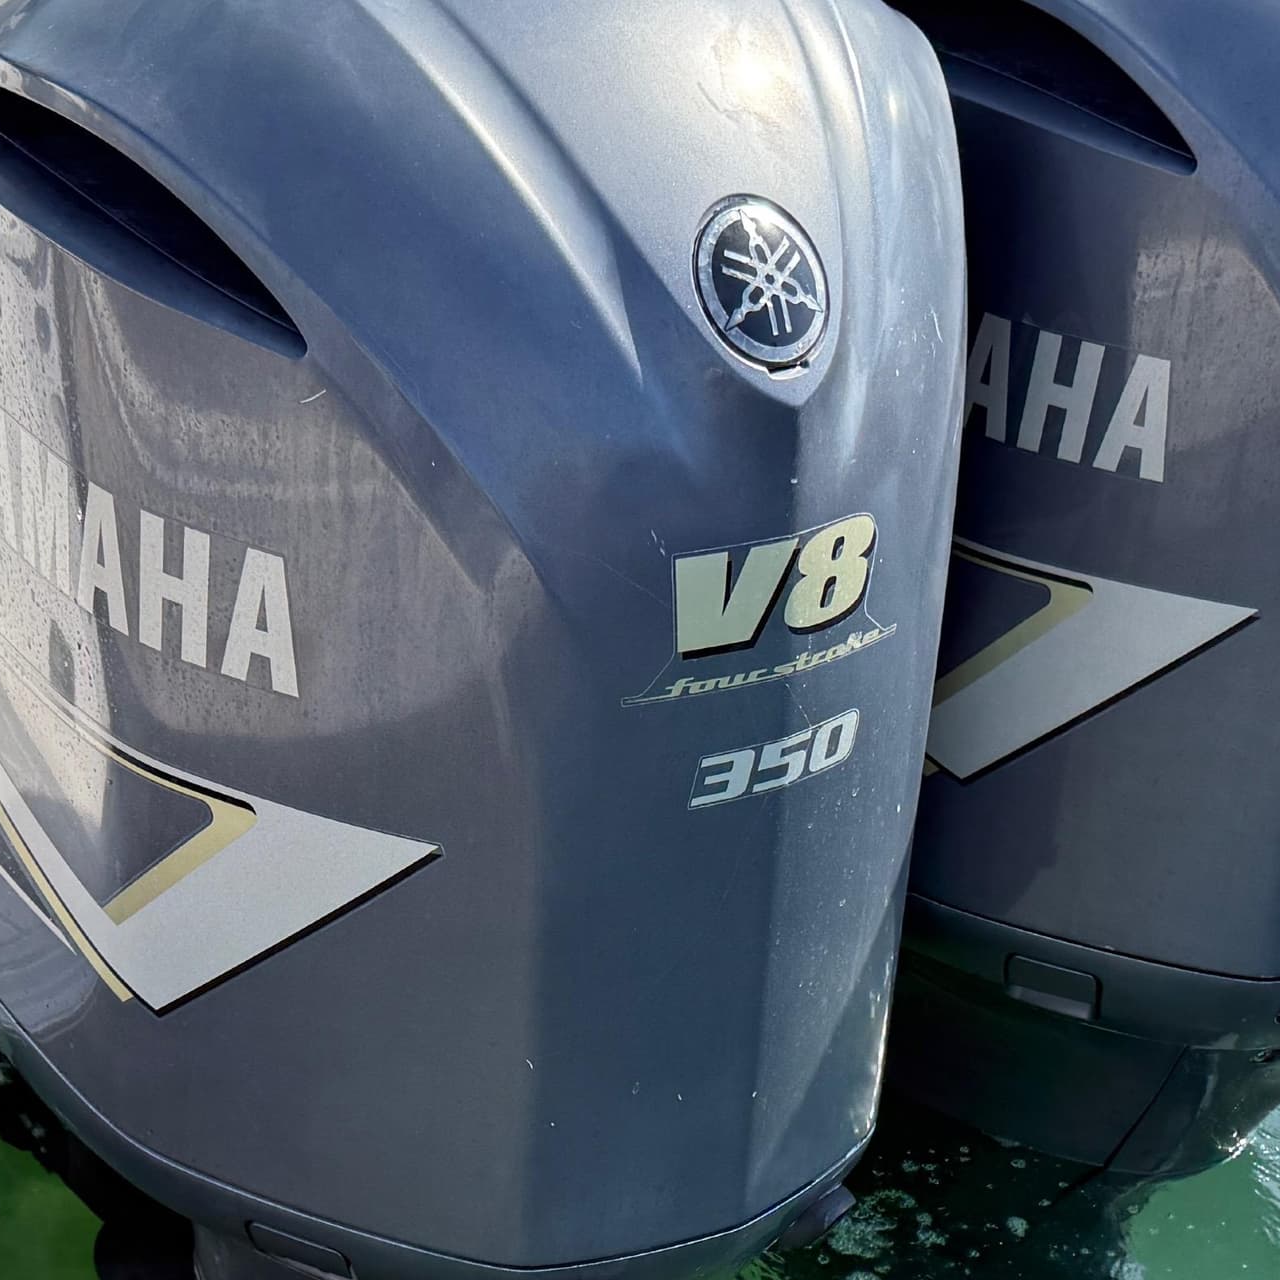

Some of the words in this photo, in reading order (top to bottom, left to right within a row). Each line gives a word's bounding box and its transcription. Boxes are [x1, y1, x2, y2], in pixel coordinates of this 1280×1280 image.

[963, 312, 1171, 483] AHA
[675, 515, 876, 660] V8
[664, 668, 769, 697] four
[773, 628, 880, 675] stroke
[689, 711, 860, 808] 350
